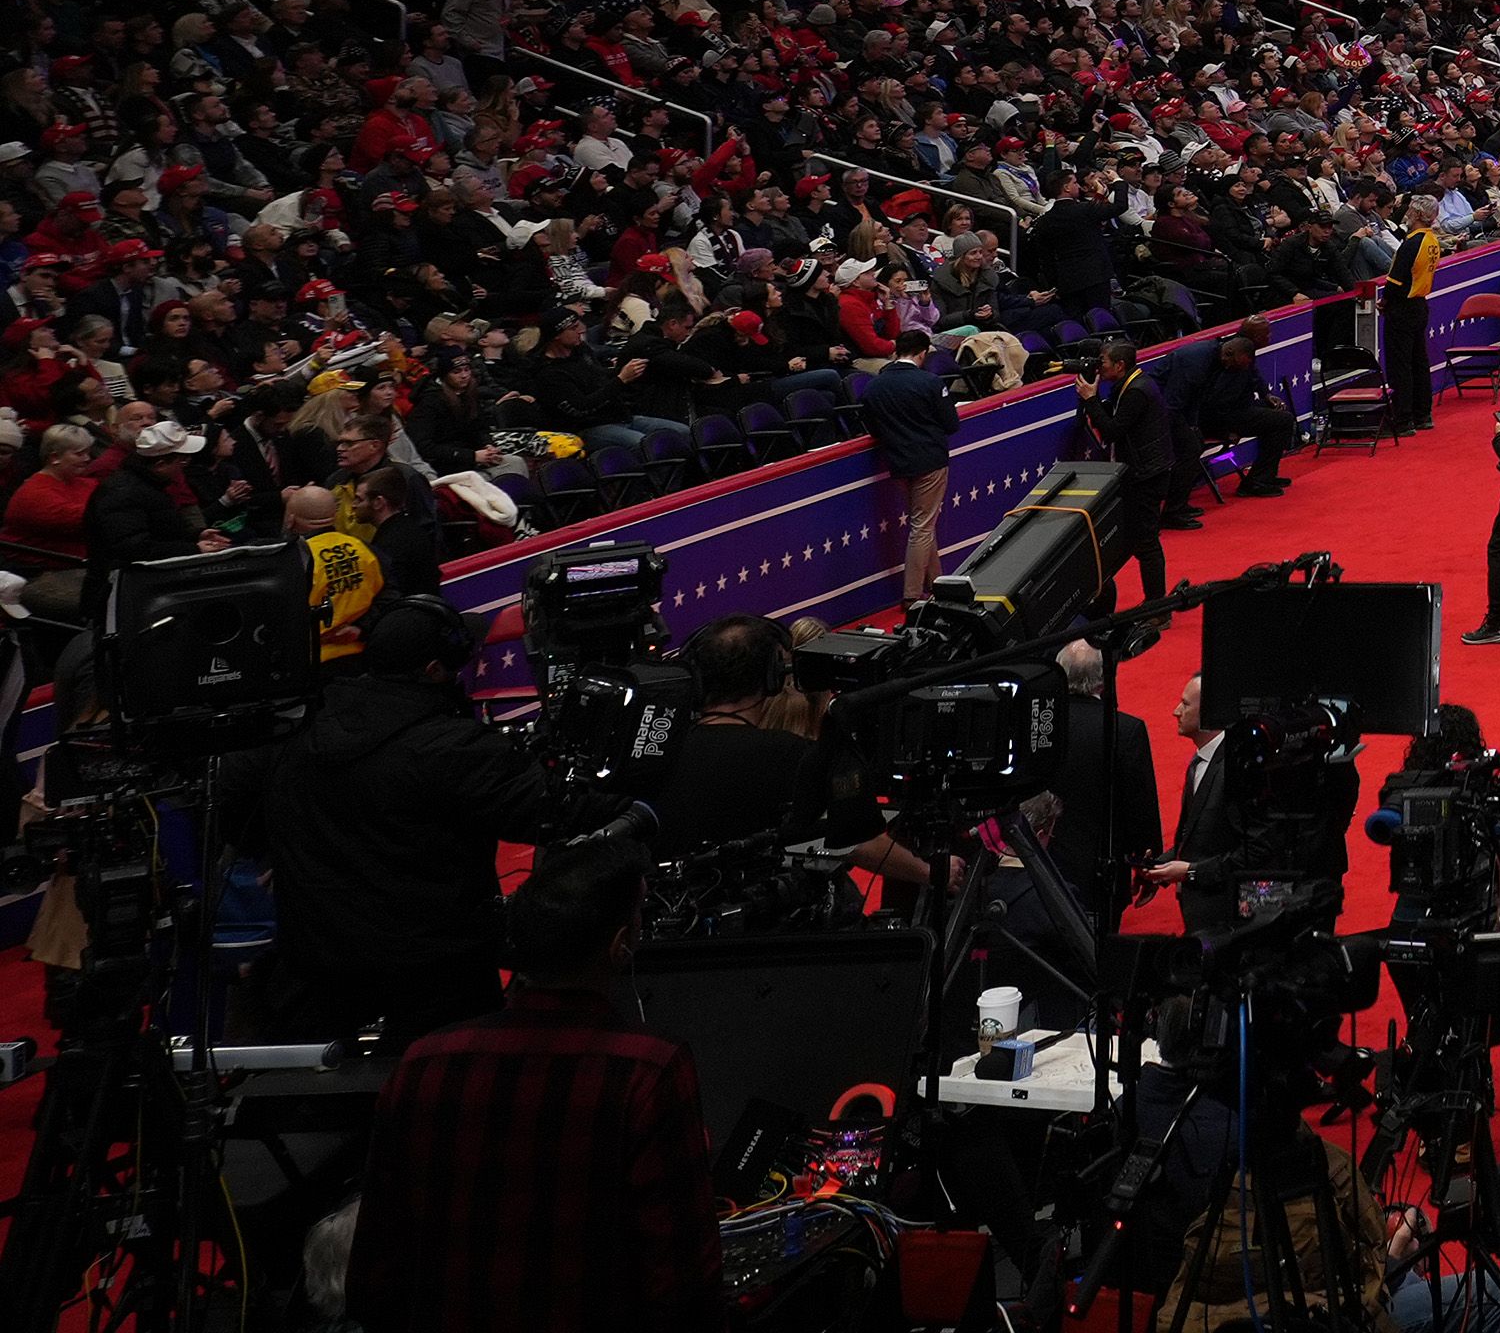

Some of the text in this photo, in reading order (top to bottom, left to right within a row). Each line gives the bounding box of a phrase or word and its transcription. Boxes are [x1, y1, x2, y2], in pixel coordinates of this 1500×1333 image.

[320, 543, 357, 562] CSC
[325, 556, 359, 580] EVENT
[631, 705, 656, 758] amaran
[738, 1128, 764, 1171] NETGEAR
